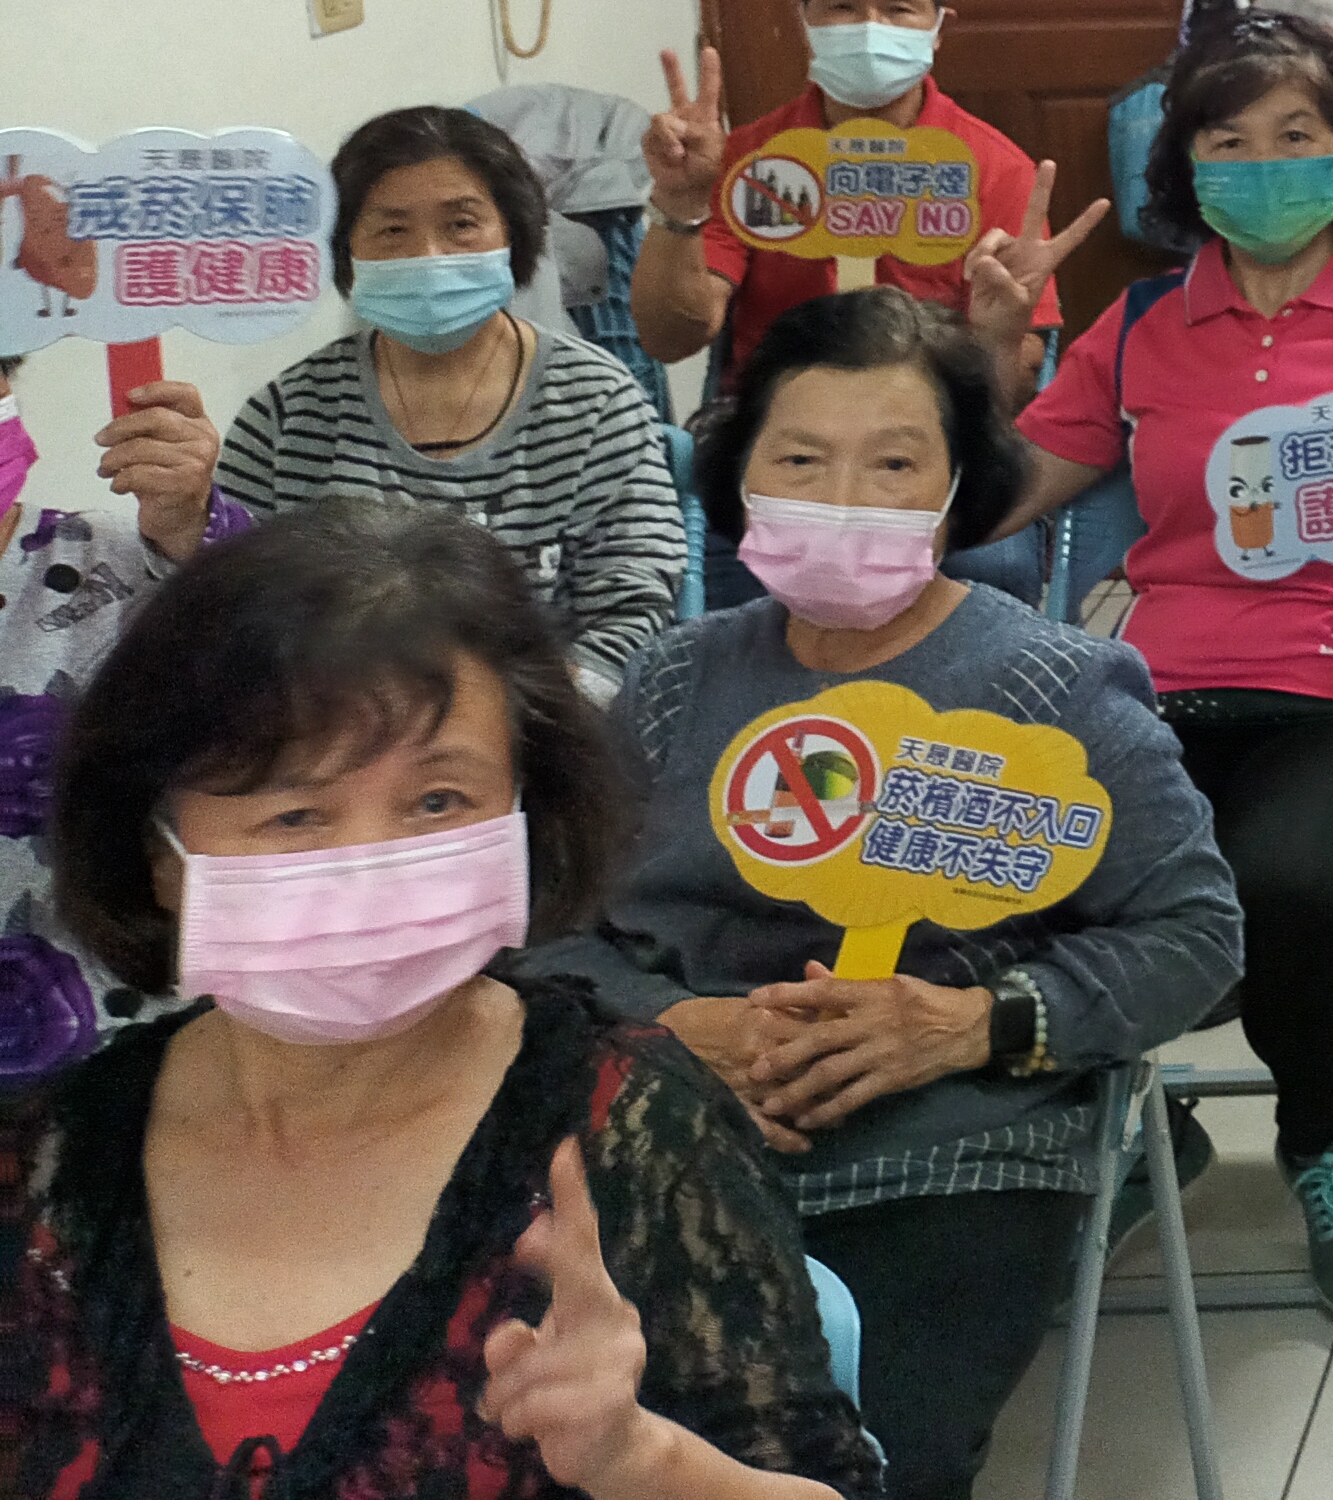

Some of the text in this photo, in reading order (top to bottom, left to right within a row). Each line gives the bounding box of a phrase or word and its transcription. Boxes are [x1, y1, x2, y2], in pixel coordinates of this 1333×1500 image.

[826, 162, 971, 198] 向電子煙
[826, 202, 972, 236] SAY NO
[115, 238, 320, 306] 護健康
[896, 737, 1005, 779] 天晟醫院
[876, 767, 1102, 848] 菸檳酒不入口
[862, 819, 1052, 891] 健康不失守
